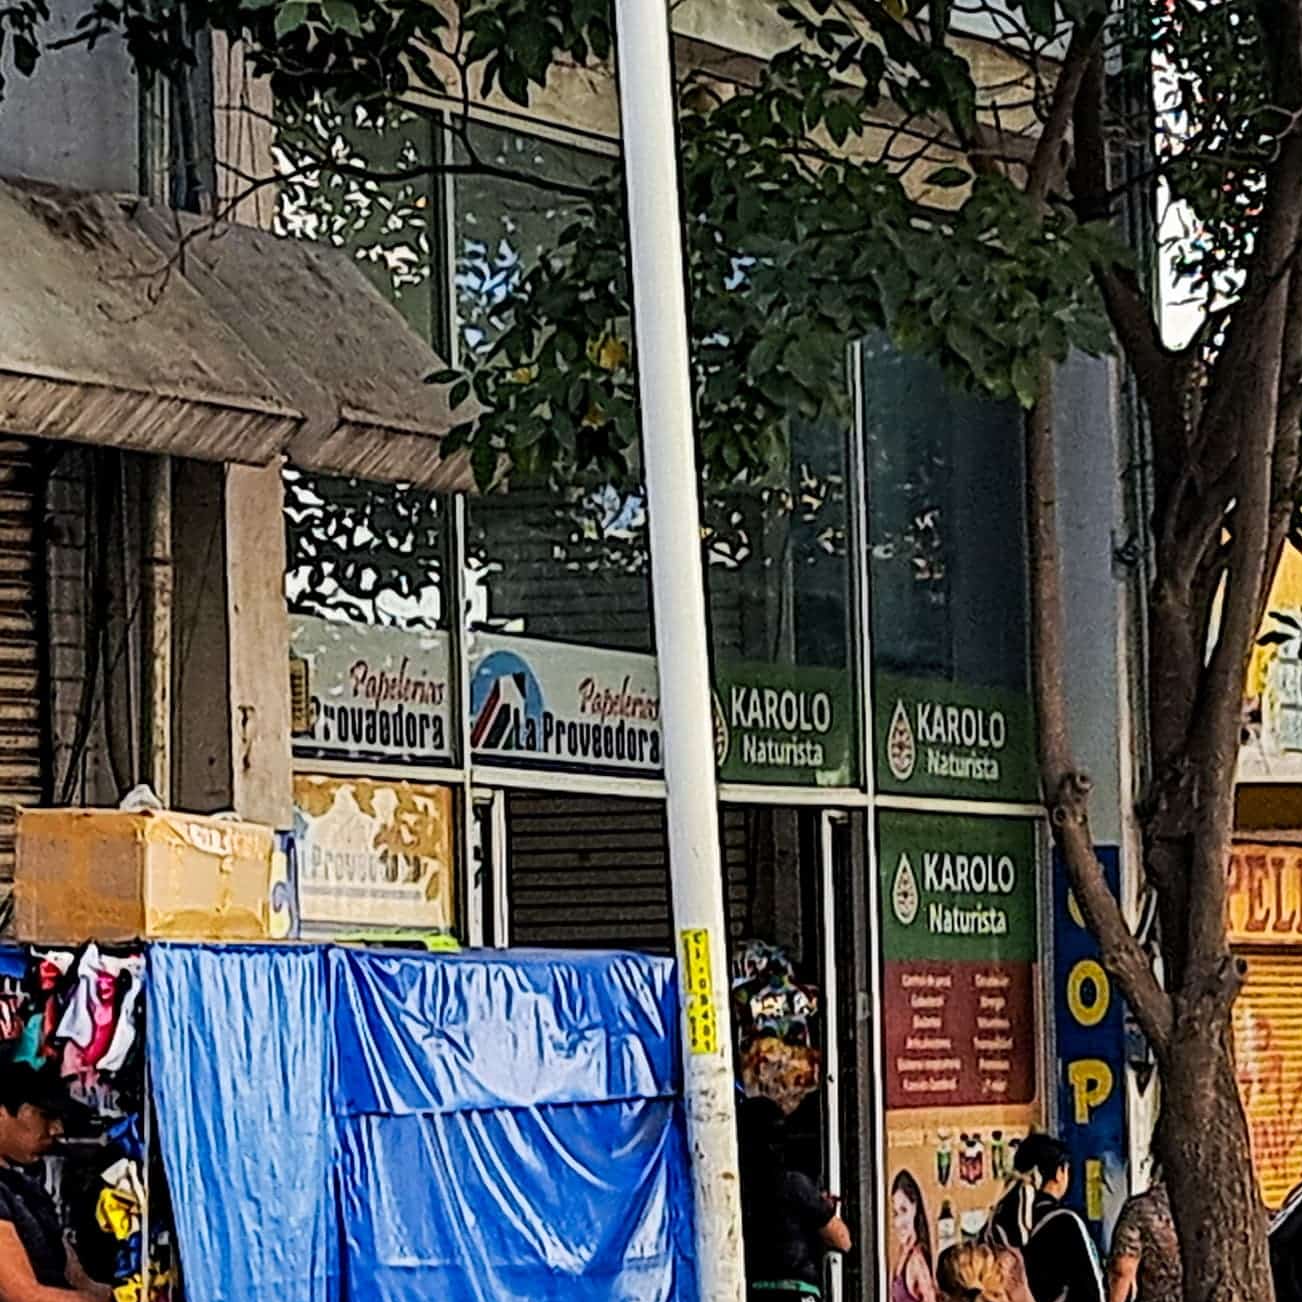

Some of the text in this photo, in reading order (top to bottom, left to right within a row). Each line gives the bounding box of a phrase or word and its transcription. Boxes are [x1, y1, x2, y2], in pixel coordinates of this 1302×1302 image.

[731, 687, 832, 733] KAROLO
[916, 703, 1006, 748] KAROLO
[543, 711, 661, 764] Proveedora
[743, 734, 824, 767] Naturista
[927, 748, 999, 780] Naturista
[923, 853, 1015, 893] KAROLO
[930, 903, 1007, 934] Naturista
